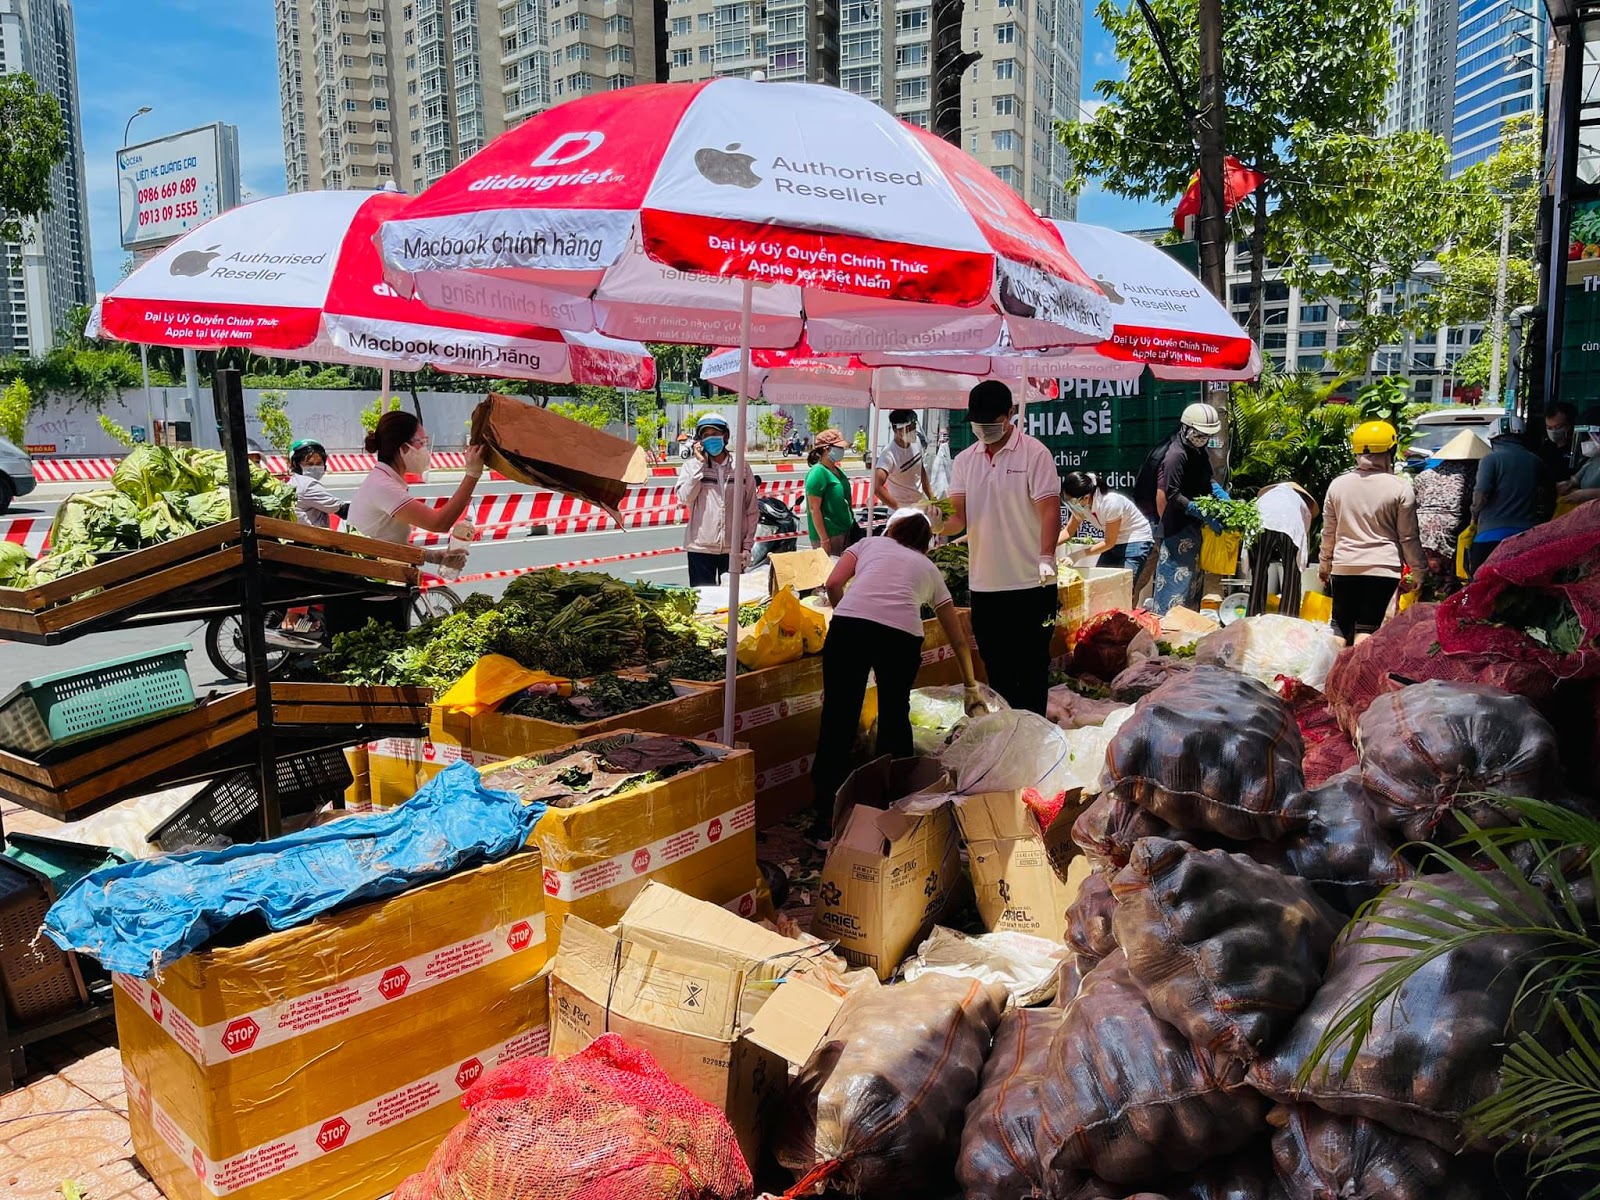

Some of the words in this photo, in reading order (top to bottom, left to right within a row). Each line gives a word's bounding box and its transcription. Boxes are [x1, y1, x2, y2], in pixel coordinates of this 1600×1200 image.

[772, 156, 923, 186] Authorised
[138, 186, 159, 204] 0986
[162, 182, 177, 199] 669
[180, 177, 197, 195] 689
[775, 178, 887, 206] Reseller
[139, 208, 160, 226] 0913
[162, 206, 173, 221] 09
[176, 200, 198, 219] 5555
[404, 234, 487, 260] Macbook
[492, 230, 547, 255] chính
[552, 232, 603, 261] hãng
[708, 236, 735, 254] Đại
[740, 241, 757, 257] Lý
[841, 253, 887, 270] Chính
[890, 259, 929, 274] Thức
[225, 252, 327, 264] Authorised
[210, 267, 286, 281] Reseller
[748, 260, 794, 279] Apple
[821, 270, 851, 287] Việt
[855, 273, 891, 290] Nam
[1123, 282, 1200, 298] Authorised
[1130, 297, 1188, 313] Reseller
[144, 312, 161, 324] Đại
[164, 312, 175, 324] Lý
[226, 316, 254, 327] Chính
[165, 327, 194, 339] Apple
[196, 329, 208, 340] tại
[210, 329, 229, 341] Việt
[230, 330, 253, 339] Nam
[1113, 335, 1127, 346] Đại
[1129, 336, 1139, 346] Lý
[1179, 340, 1200, 351] Chính
[349, 332, 439, 356] Macbook
[443, 343, 493, 362] chính
[497, 347, 541, 370] hãng
[1132, 349, 1157, 359] Apple
[1184, 354, 1202, 364] Nam
[1582, 340, 1600, 352] cùn
[1083, 401, 1112, 435] SẺ
[1106, 471, 1136, 489] dịch
[709, 824, 721, 837] STOP
[635, 855, 649, 868] STOP
[823, 912, 858, 930] ARIEL
[1002, 910, 1031, 921] ARIEL
[510, 929, 530, 945] STOP
[436, 954, 463, 967] Package
[464, 942, 492, 956] Damaged
[425, 967, 446, 977] Check
[446, 956, 474, 970] Contents
[382, 973, 406, 993] STOP
[280, 1013, 290, 1021] Or
[291, 1002, 324, 1017] Package
[325, 989, 359, 1005] Damaged
[297, 996, 314, 1008] Seal
[315, 994, 323, 1002] Is
[323, 986, 350, 999] Broken
[278, 1018, 302, 1029] Check
[304, 1005, 338, 1021] Contents
[339, 996, 363, 1008] Before
[292, 1018, 320, 1031] Signing
[322, 1008, 350, 1021] Receipt
[573, 1005, 590, 1026] P&G
[227, 1026, 255, 1046] STOP
[460, 1065, 480, 1083] STOP
[378, 1098, 407, 1113] Package
[408, 1083, 439, 1100] Damaged
[384, 1095, 399, 1106] Seal
[367, 1114, 388, 1126] Check
[390, 1100, 419, 1115] Contents
[379, 1114, 404, 1127] Signing
[405, 1101, 430, 1116] Receipt
[321, 1125, 346, 1145] STOP
[259, 1142, 286, 1157] Broken
[214, 1176, 237, 1187] Check
[239, 1162, 273, 1178] Contents
[274, 1151, 299, 1164] Before
[226, 1160, 259, 1177] Package
[260, 1144, 296, 1163] Damaged
[227, 1176, 255, 1191] Signing
[257, 1163, 286, 1178] Receipt
